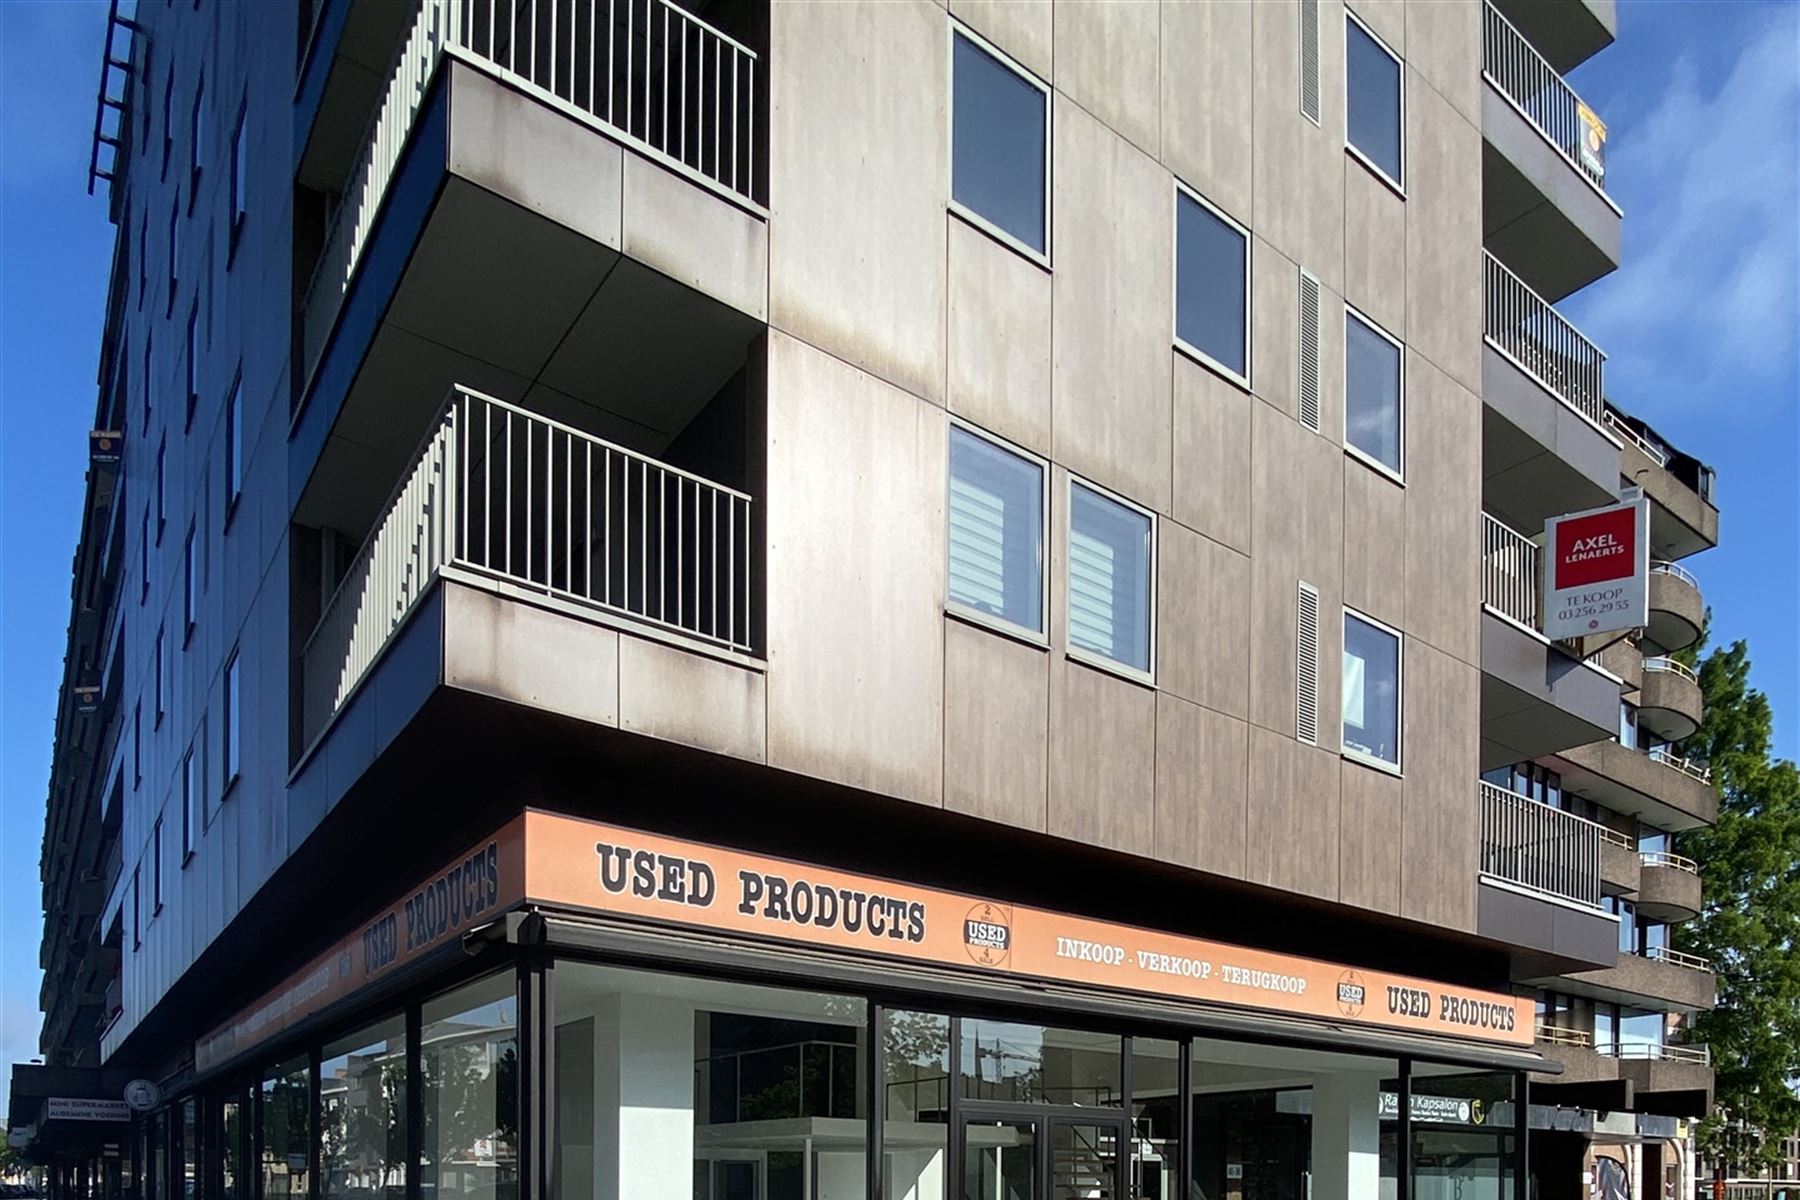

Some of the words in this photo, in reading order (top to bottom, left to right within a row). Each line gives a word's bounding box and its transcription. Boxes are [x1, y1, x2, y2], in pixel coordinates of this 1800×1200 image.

[1573, 533, 1618, 552] AXEL
[1565, 545, 1625, 563] LENAERTS
[1567, 595, 1581, 607] TE
[1583, 588, 1624, 605] KOOP
[1558, 609, 1573, 621] 03
[1575, 605, 1597, 618] 256
[1599, 602, 1613, 614] 29
[1615, 599, 1629, 611] 55
[595, 842, 716, 908] USED
[737, 869, 926, 944] PRODUCTS
[363, 911, 397, 978] USED
[405, 841, 498, 953] PRODUCTS
[968, 921, 1007, 942] USED
[1056, 937, 1125, 966] INKOOP
[1136, 950, 1211, 979] VERKOOP
[1221, 965, 1307, 994] TERUGKOOP
[1339, 983, 1364, 1000] USED
[1386, 985, 1431, 1019] USED
[1439, 994, 1515, 1032] PRODUCTS
[1417, 1096, 1459, 1111] Kapsalon
